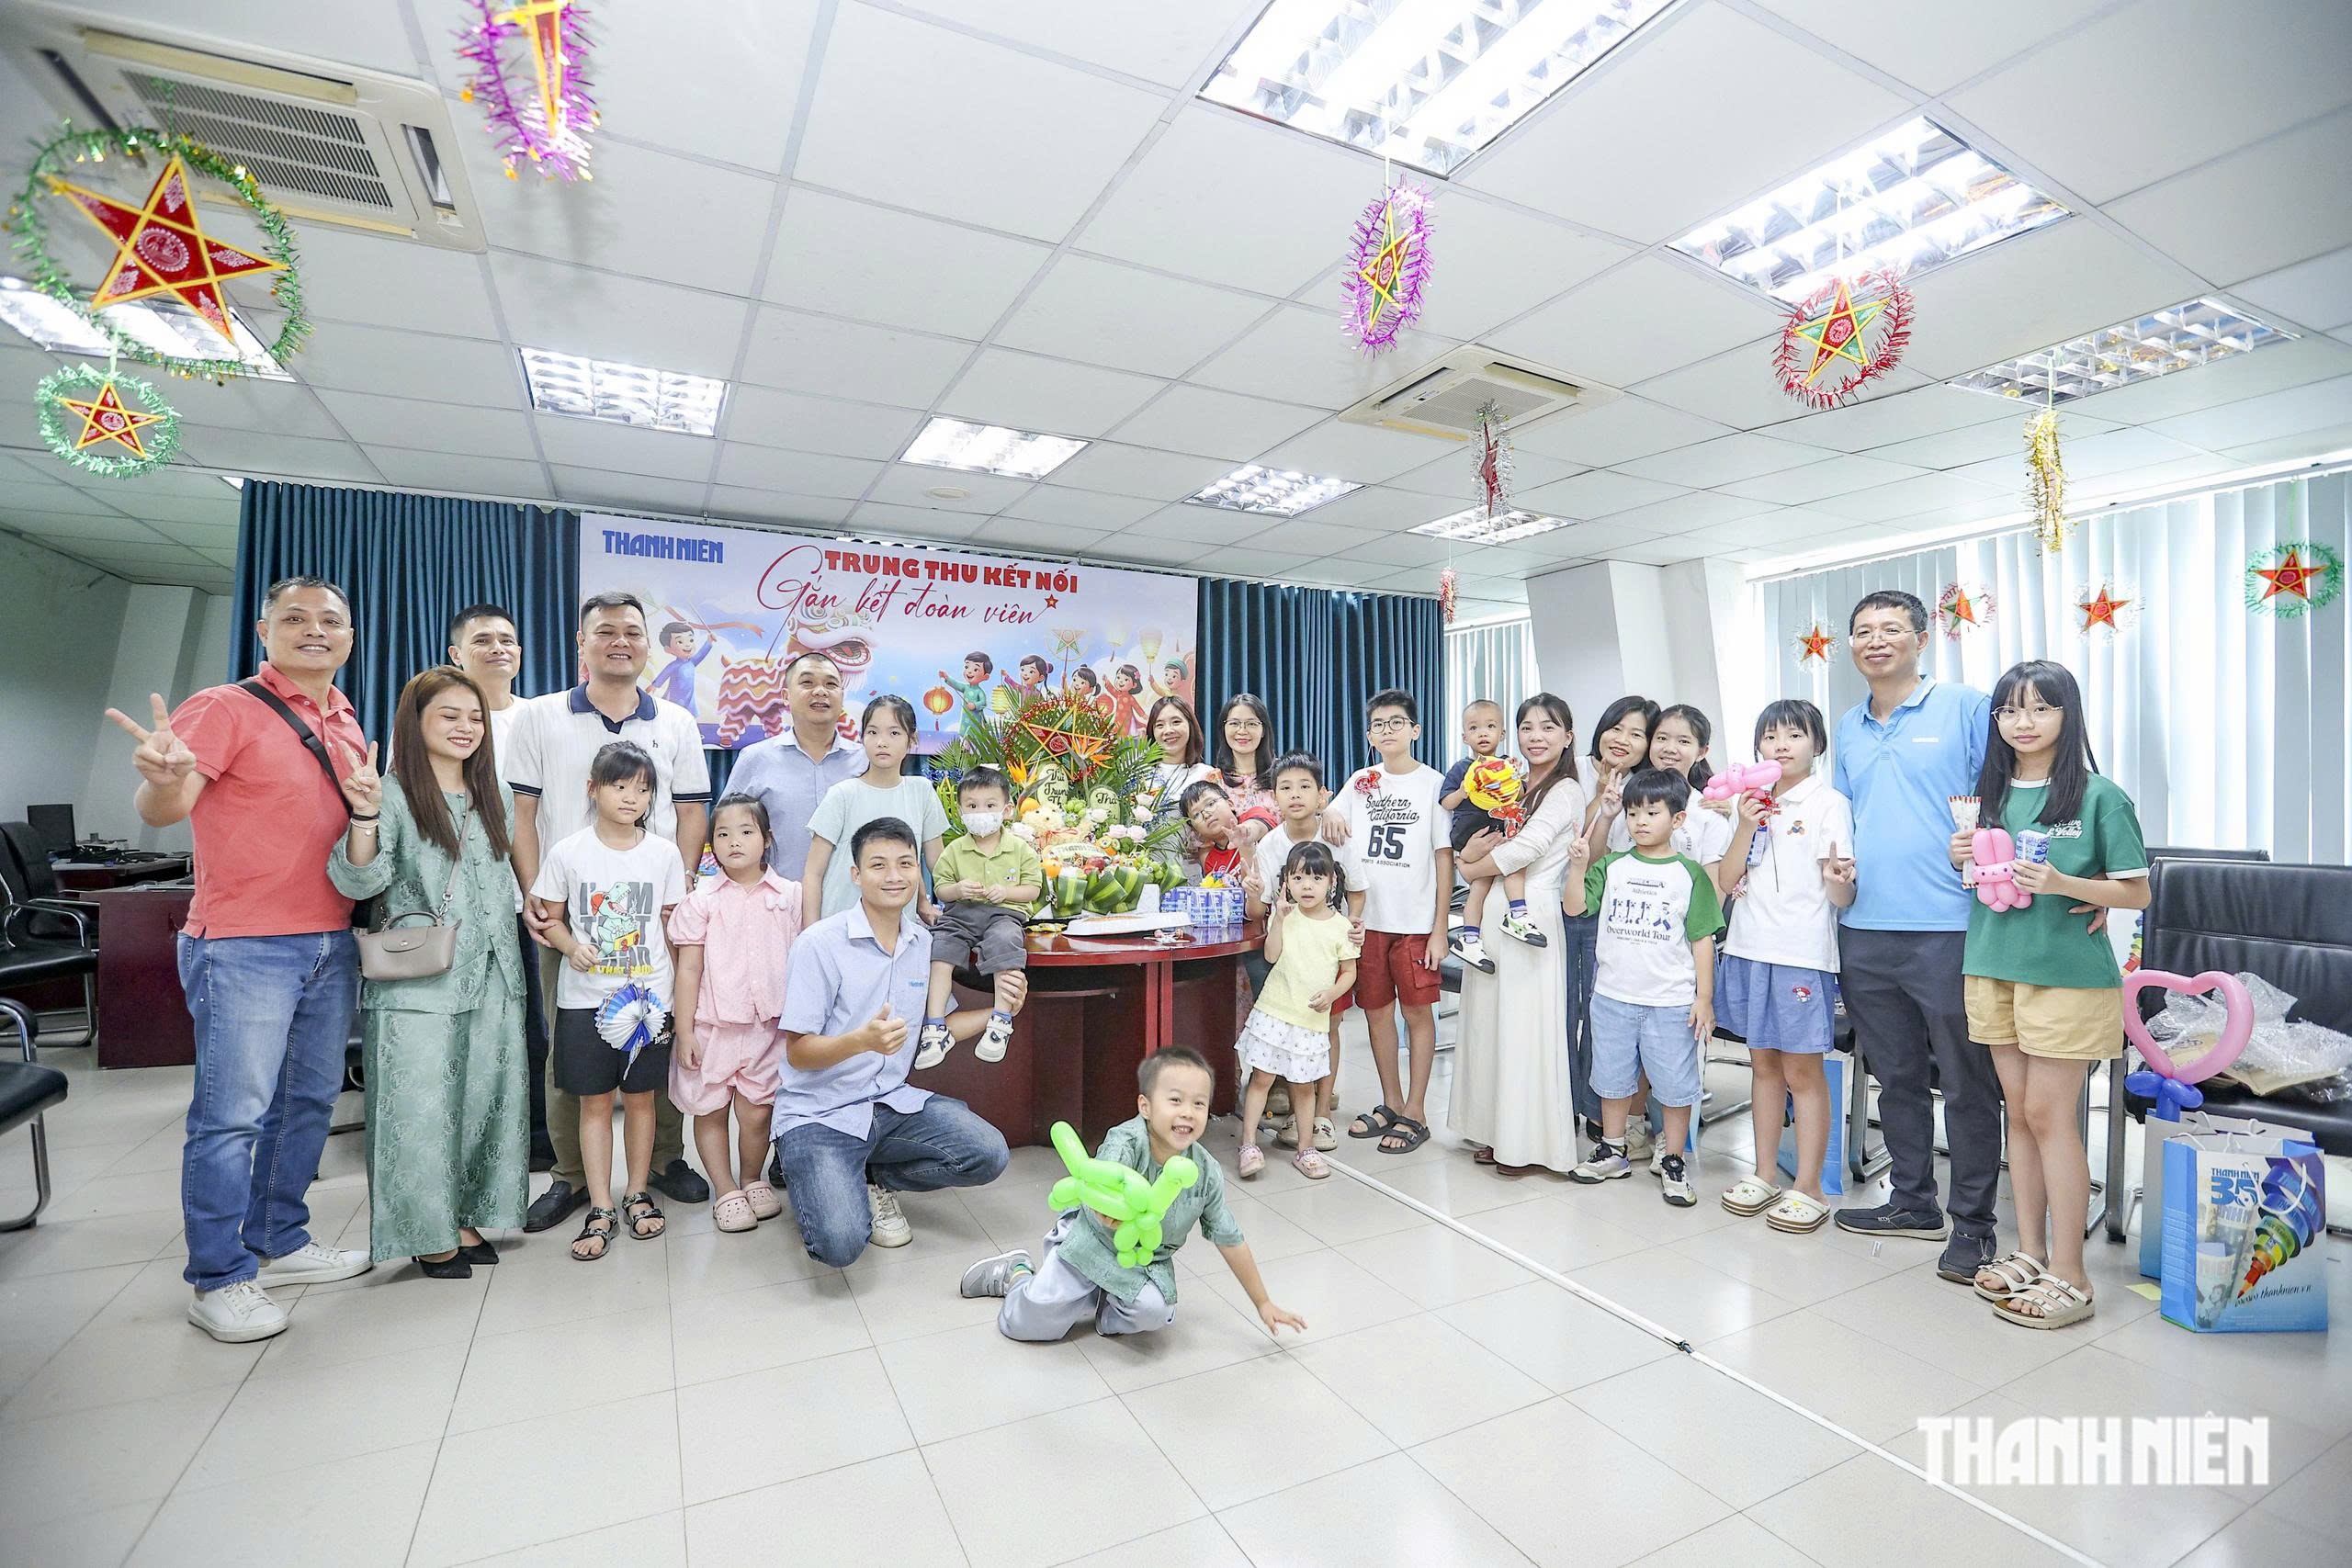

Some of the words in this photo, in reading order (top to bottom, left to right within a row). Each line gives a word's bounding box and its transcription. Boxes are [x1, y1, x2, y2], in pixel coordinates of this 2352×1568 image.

[602, 530, 675, 559] THANH
[825, 550, 920, 579] TRUNG
[924, 560, 978, 583] THU
[984, 562, 1031, 589] KẾT
[1035, 568, 1078, 593] NỐI
[757, 545, 846, 662] Gắn
[855, 578, 908, 622] kết
[905, 582, 975, 618] đoàn
[984, 604, 1041, 625] viên
[1365, 794, 1411, 811] Southern
[1367, 808, 1420, 827] California
[1367, 825, 1406, 860] 65
[1607, 925, 1651, 938] Overworld
[1653, 931, 1670, 941] Tour
[2211, 1176, 2258, 1206] 35
